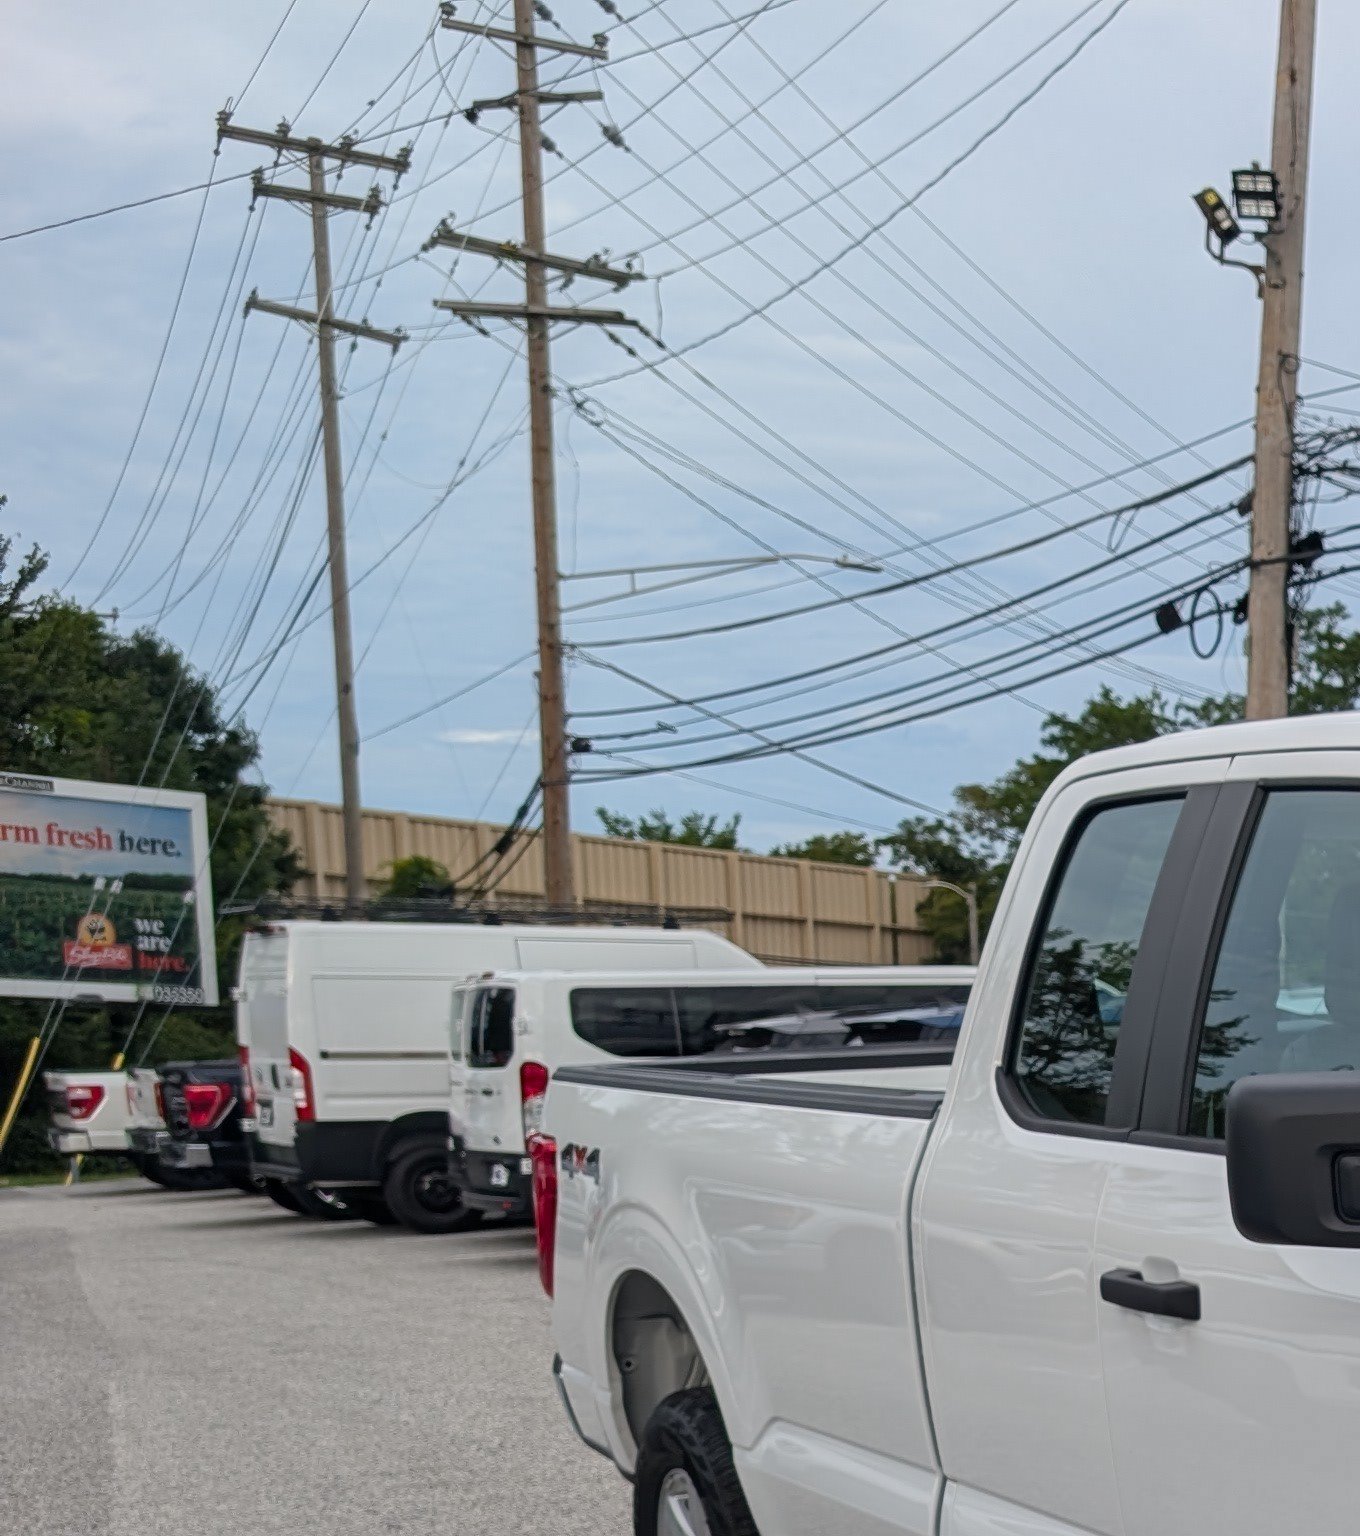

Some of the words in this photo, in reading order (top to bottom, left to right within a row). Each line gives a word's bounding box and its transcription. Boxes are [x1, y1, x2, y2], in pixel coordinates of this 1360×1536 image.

[0, 823, 39, 844] rm
[46, 822, 113, 851] fresh
[118, 829, 182, 858] here.
